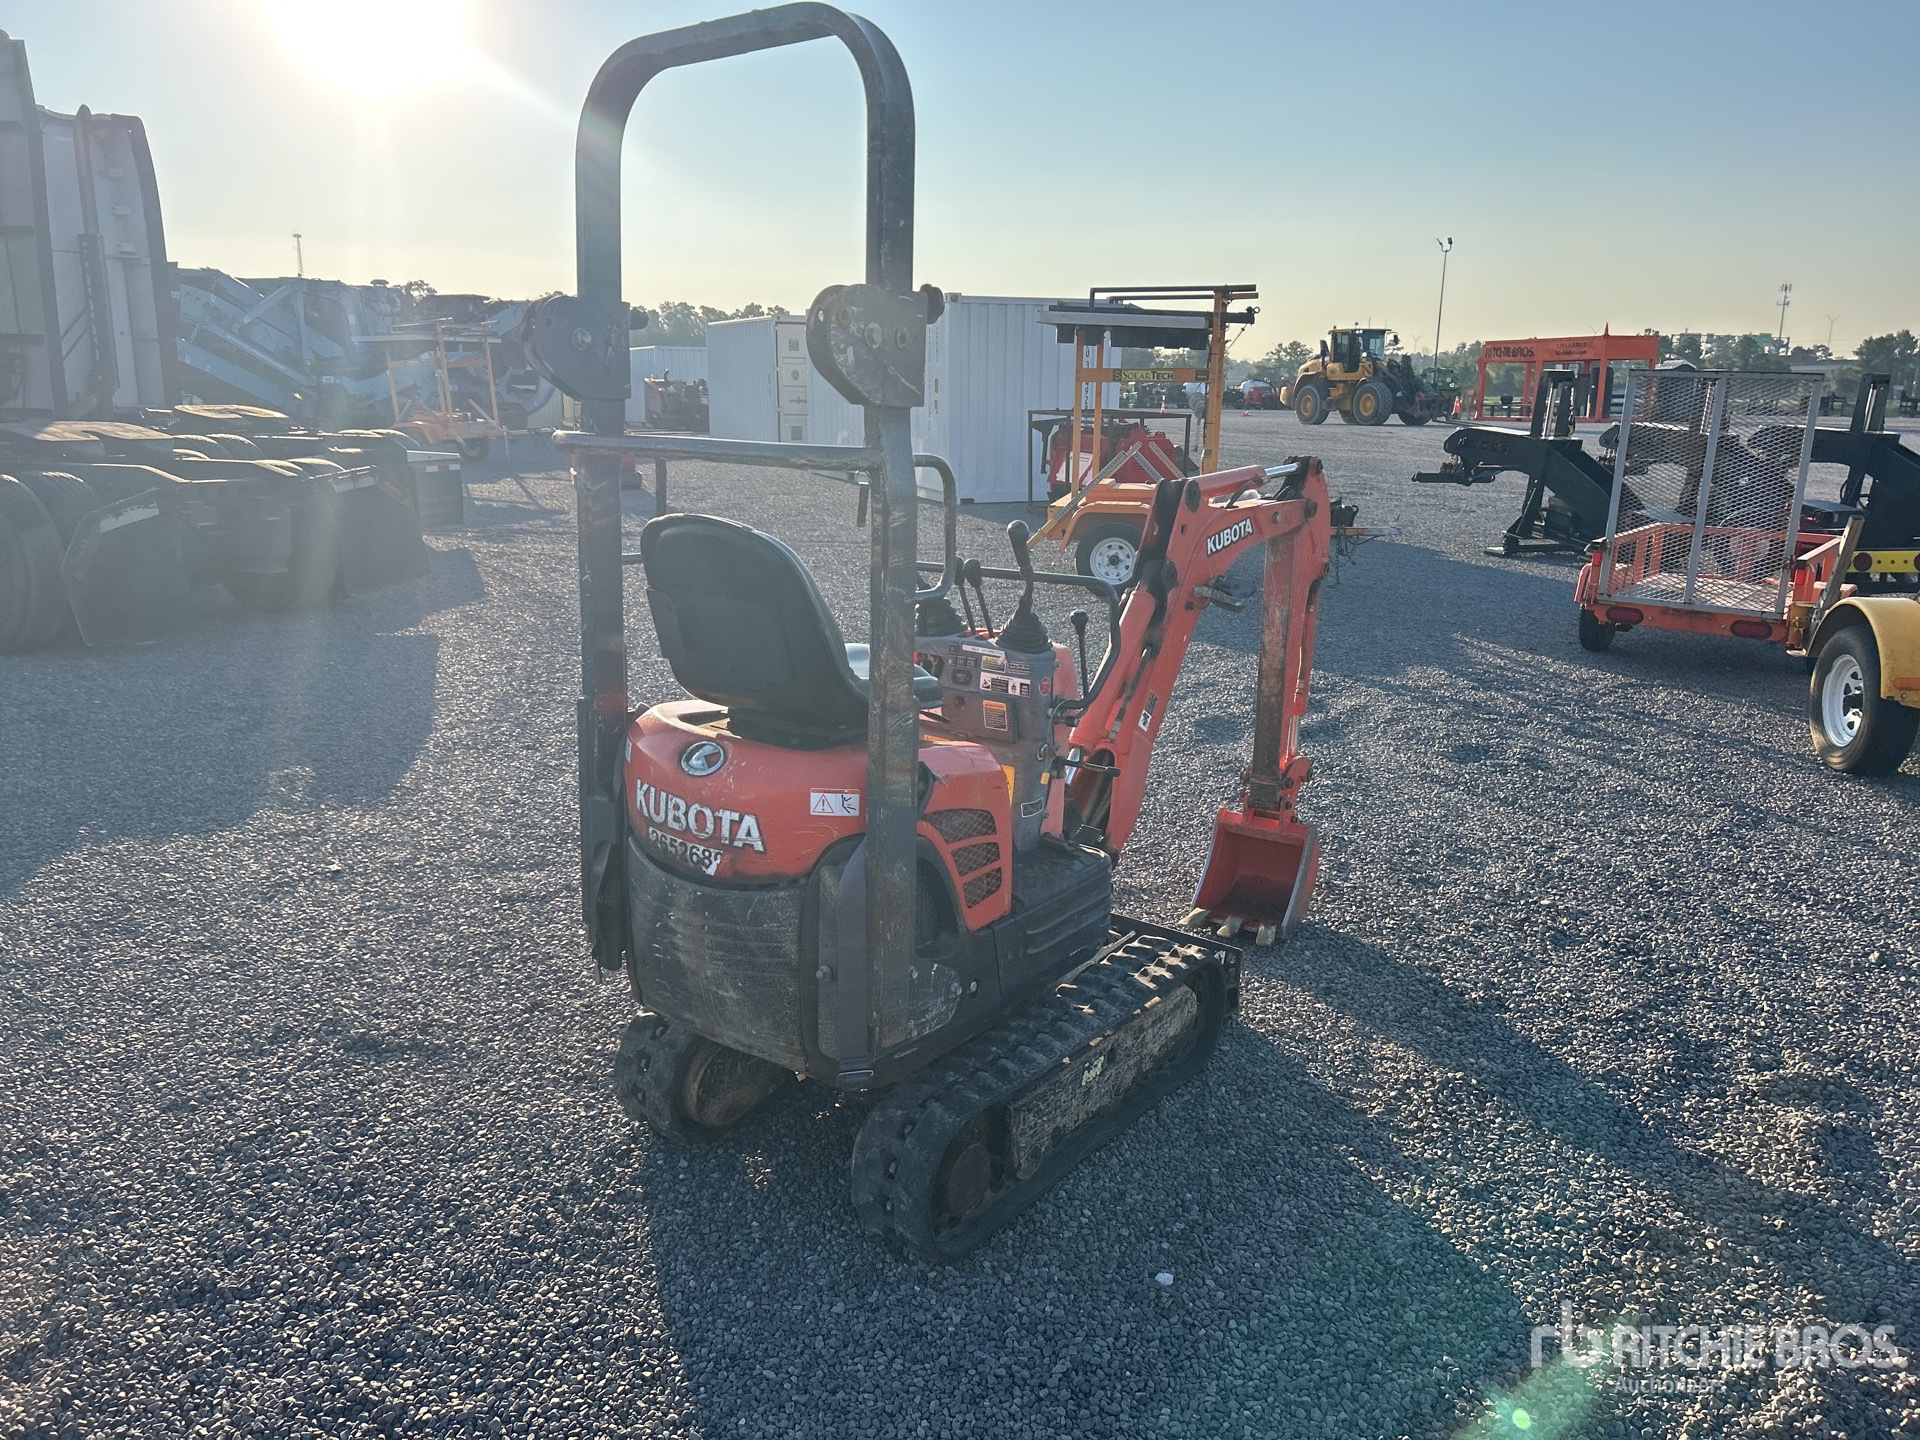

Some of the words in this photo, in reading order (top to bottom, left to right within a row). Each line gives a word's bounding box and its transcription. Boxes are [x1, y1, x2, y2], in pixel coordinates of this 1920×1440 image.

[1485, 347, 1511, 358] RITCHIE
[1512, 346, 1535, 357] BROS.
[1207, 518, 1253, 555] KUBOTA
[636, 778, 766, 853] KUBOTA
